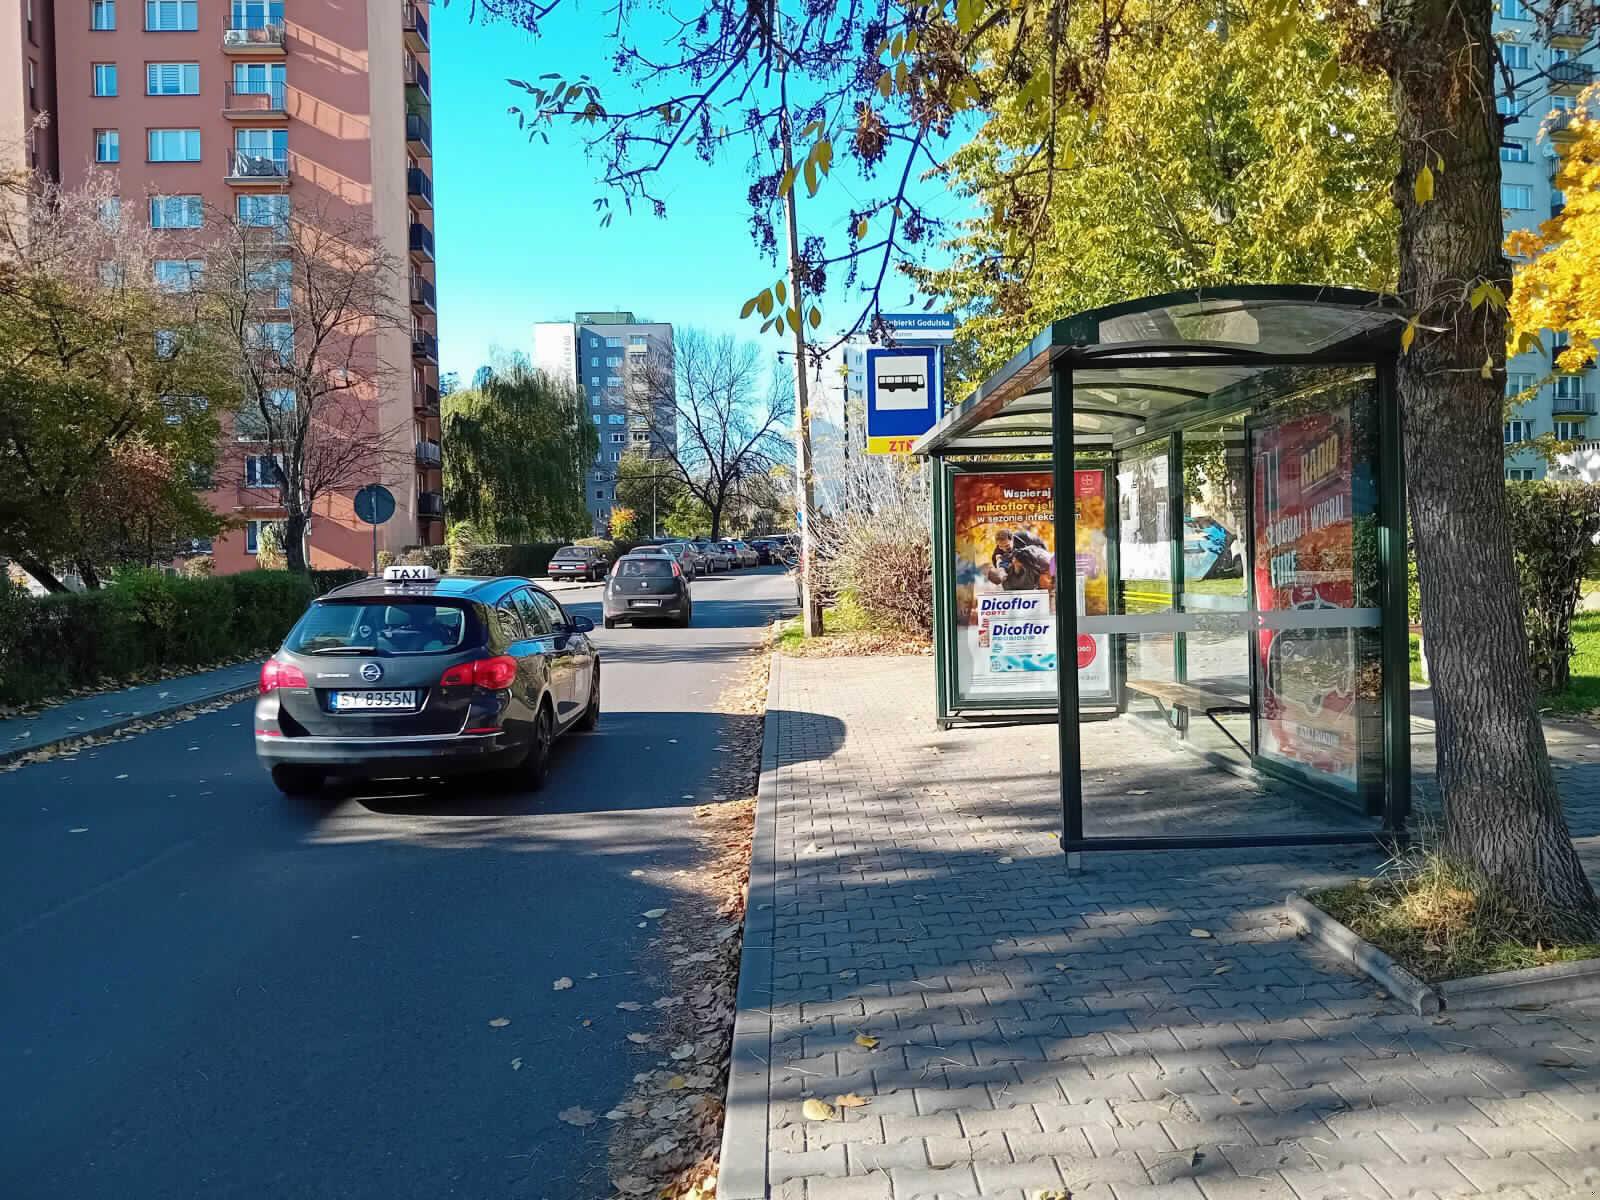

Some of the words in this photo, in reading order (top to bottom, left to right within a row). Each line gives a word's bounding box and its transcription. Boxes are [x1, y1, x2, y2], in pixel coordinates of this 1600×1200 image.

[917, 319, 950, 327] Godulska
[1300, 433, 1339, 488] RADIO
[1003, 488, 1051, 499] Wspieraj
[990, 514, 1023, 522] sezonie
[391, 568, 426, 579] TAXI
[981, 597, 1038, 610] Dicoflor
[992, 623, 1049, 636] Dicoflor
[341, 691, 360, 706] SY
[366, 691, 412, 706] 8355N
